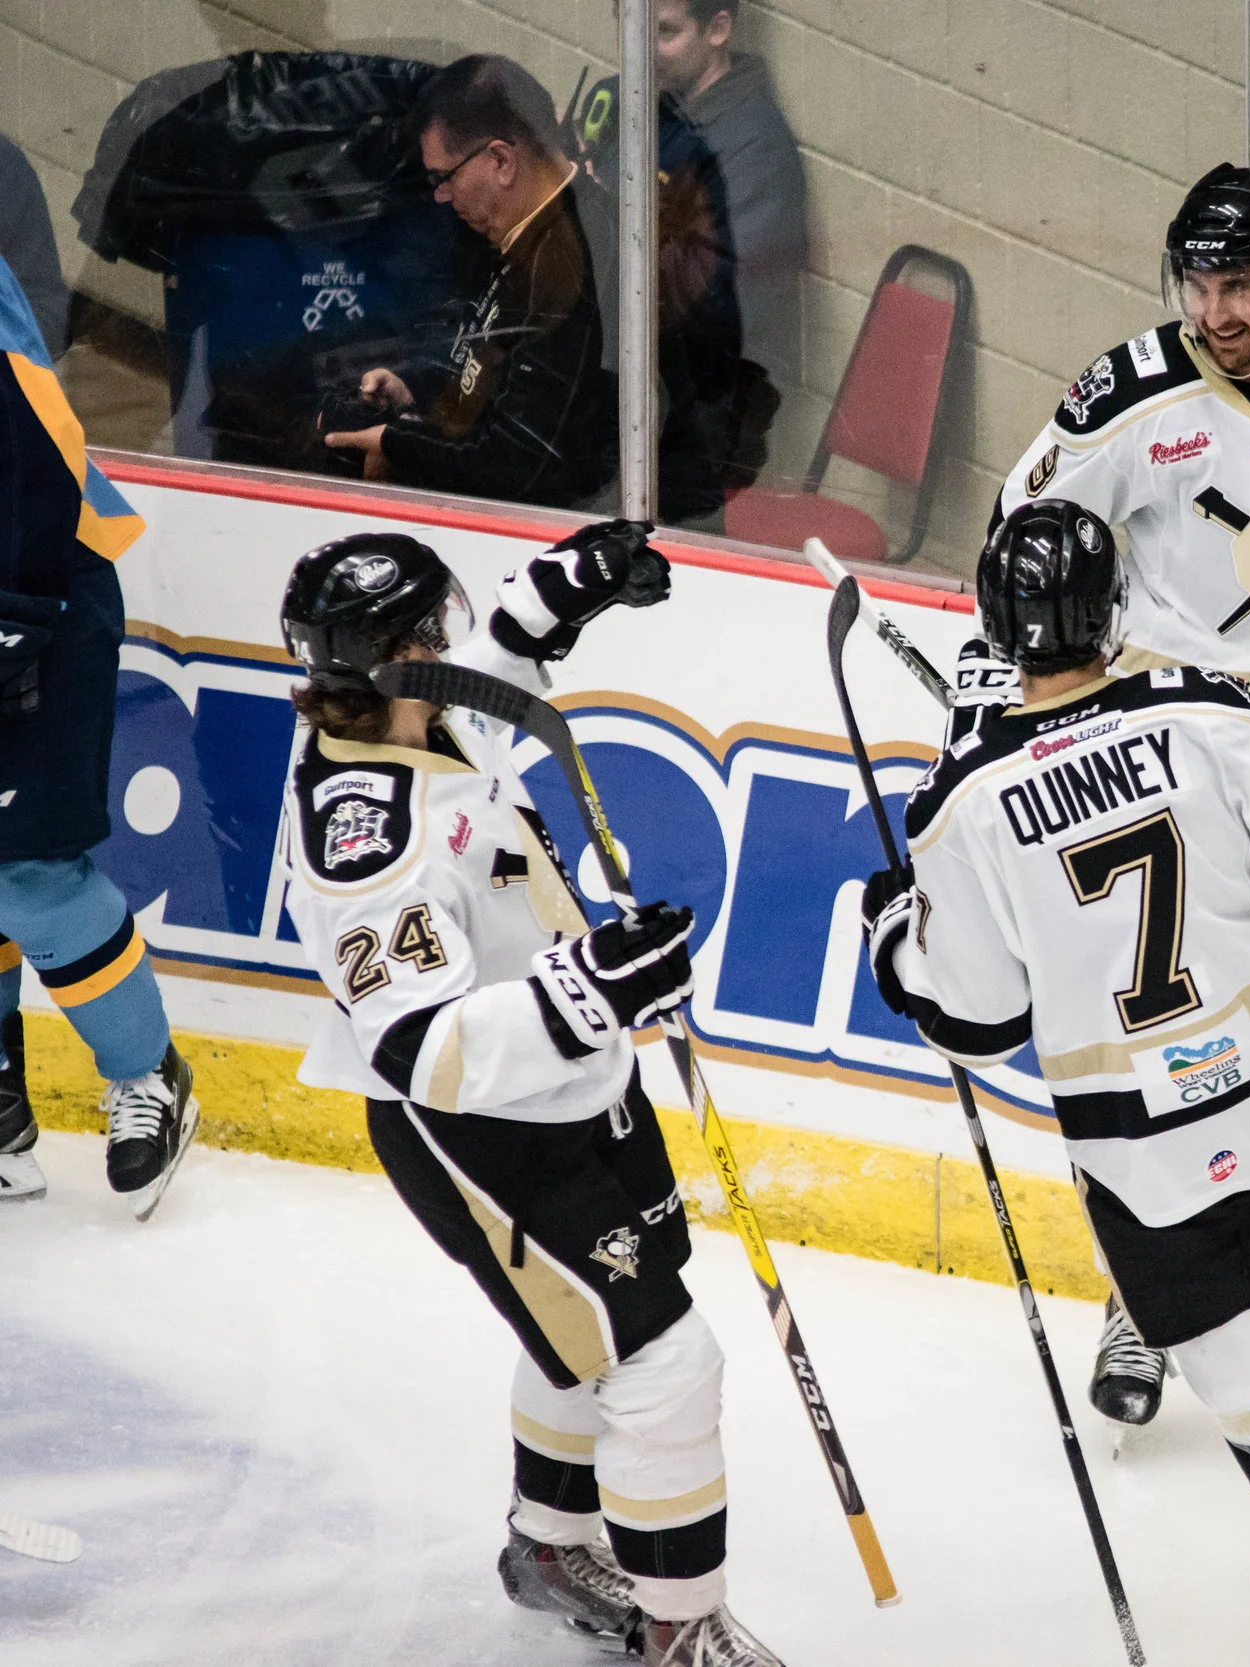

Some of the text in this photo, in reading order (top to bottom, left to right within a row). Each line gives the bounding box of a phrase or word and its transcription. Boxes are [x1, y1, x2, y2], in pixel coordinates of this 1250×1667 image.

[1184, 239, 1226, 250] CCM
[301, 271, 366, 288] RECYCLE
[323, 262, 345, 274] WE
[593, 550, 613, 581] CCM
[1026, 624, 1043, 648] 7
[1035, 703, 1101, 732] CCM
[1030, 717, 1122, 761] Coors LIGHT
[1000, 727, 1179, 846] QUINNEY
[1057, 806, 1204, 1035] 7
[334, 902, 448, 1005] 24
[542, 950, 611, 1037] CCM
[1172, 1054, 1242, 1086] Wheeling
[1180, 1068, 1242, 1104] CVB
[791, 1353, 833, 1433] CCM
